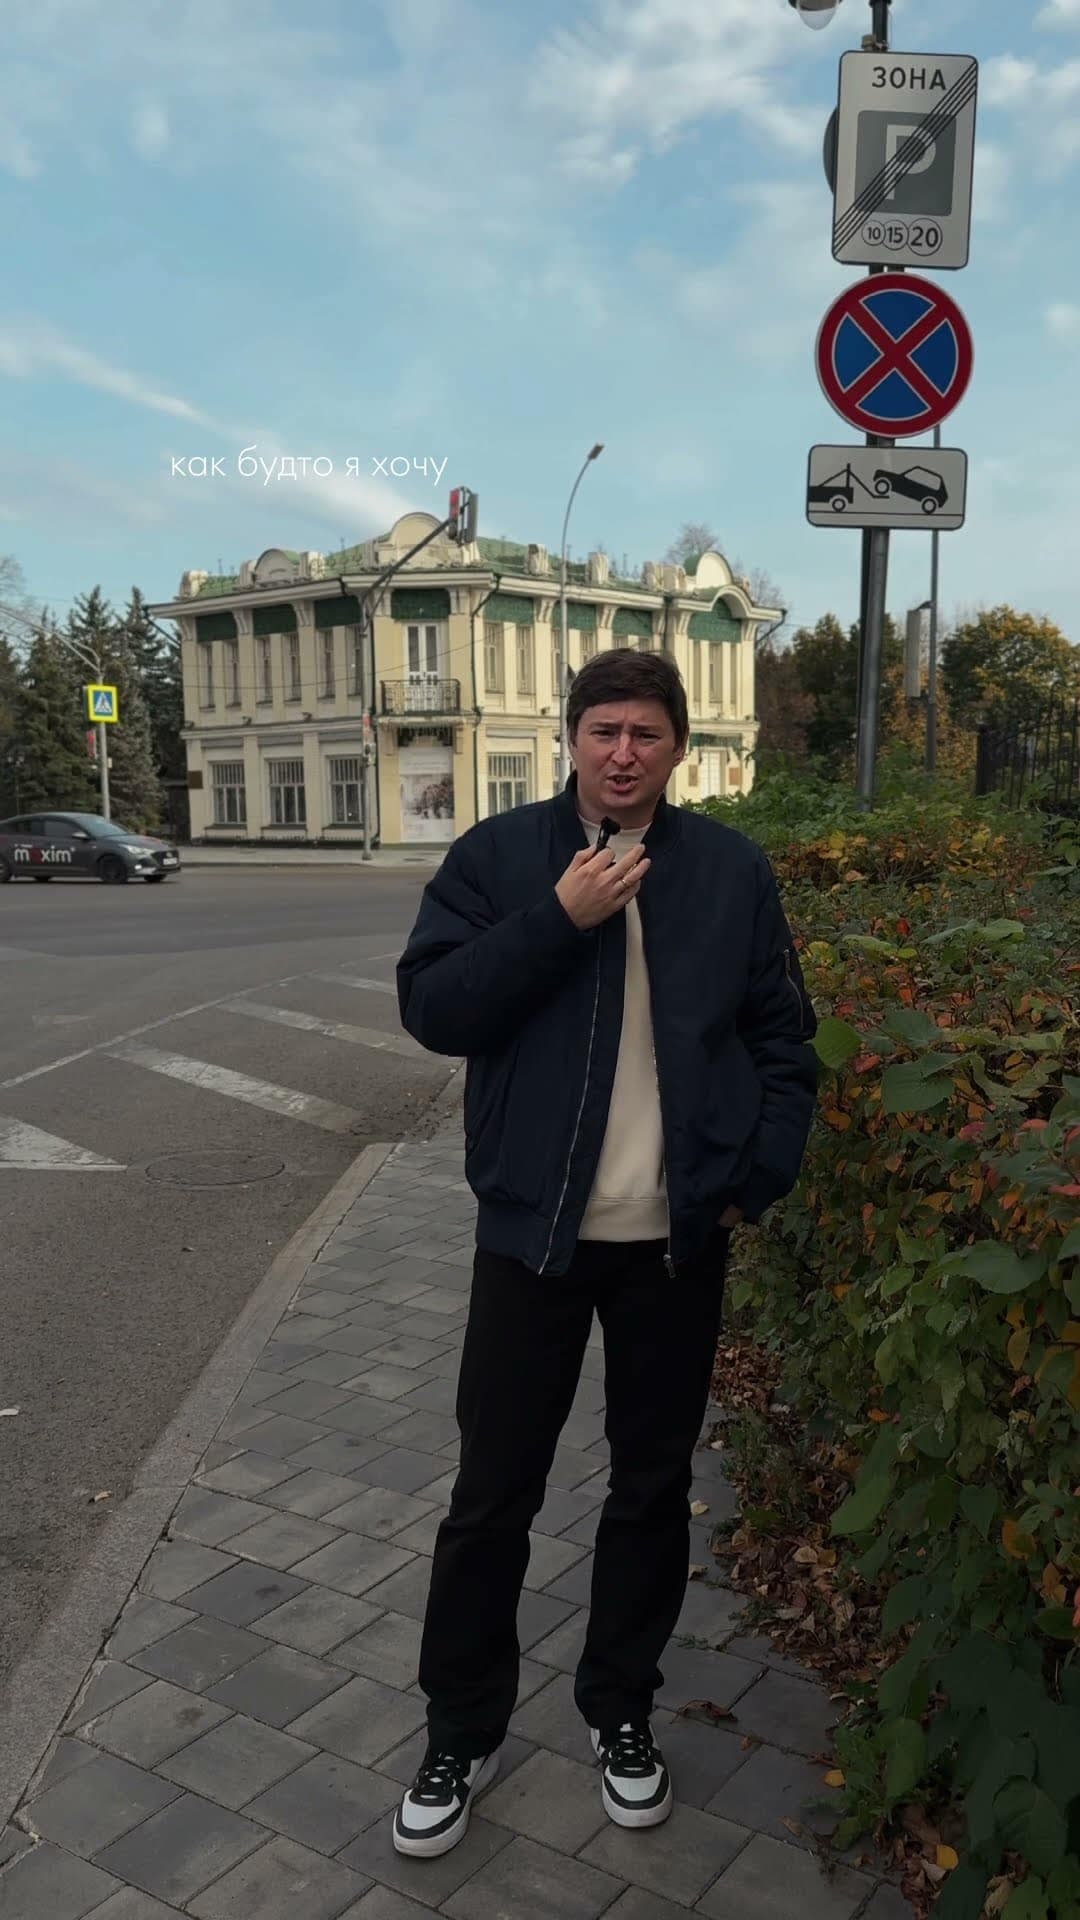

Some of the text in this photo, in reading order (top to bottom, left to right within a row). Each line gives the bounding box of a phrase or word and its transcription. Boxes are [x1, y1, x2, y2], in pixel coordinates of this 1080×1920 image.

[871, 66, 947, 91] ЗОНА
[884, 124, 937, 200] P
[867, 226, 939, 247] 10 15 20
[14, 845, 72, 863] mxim
